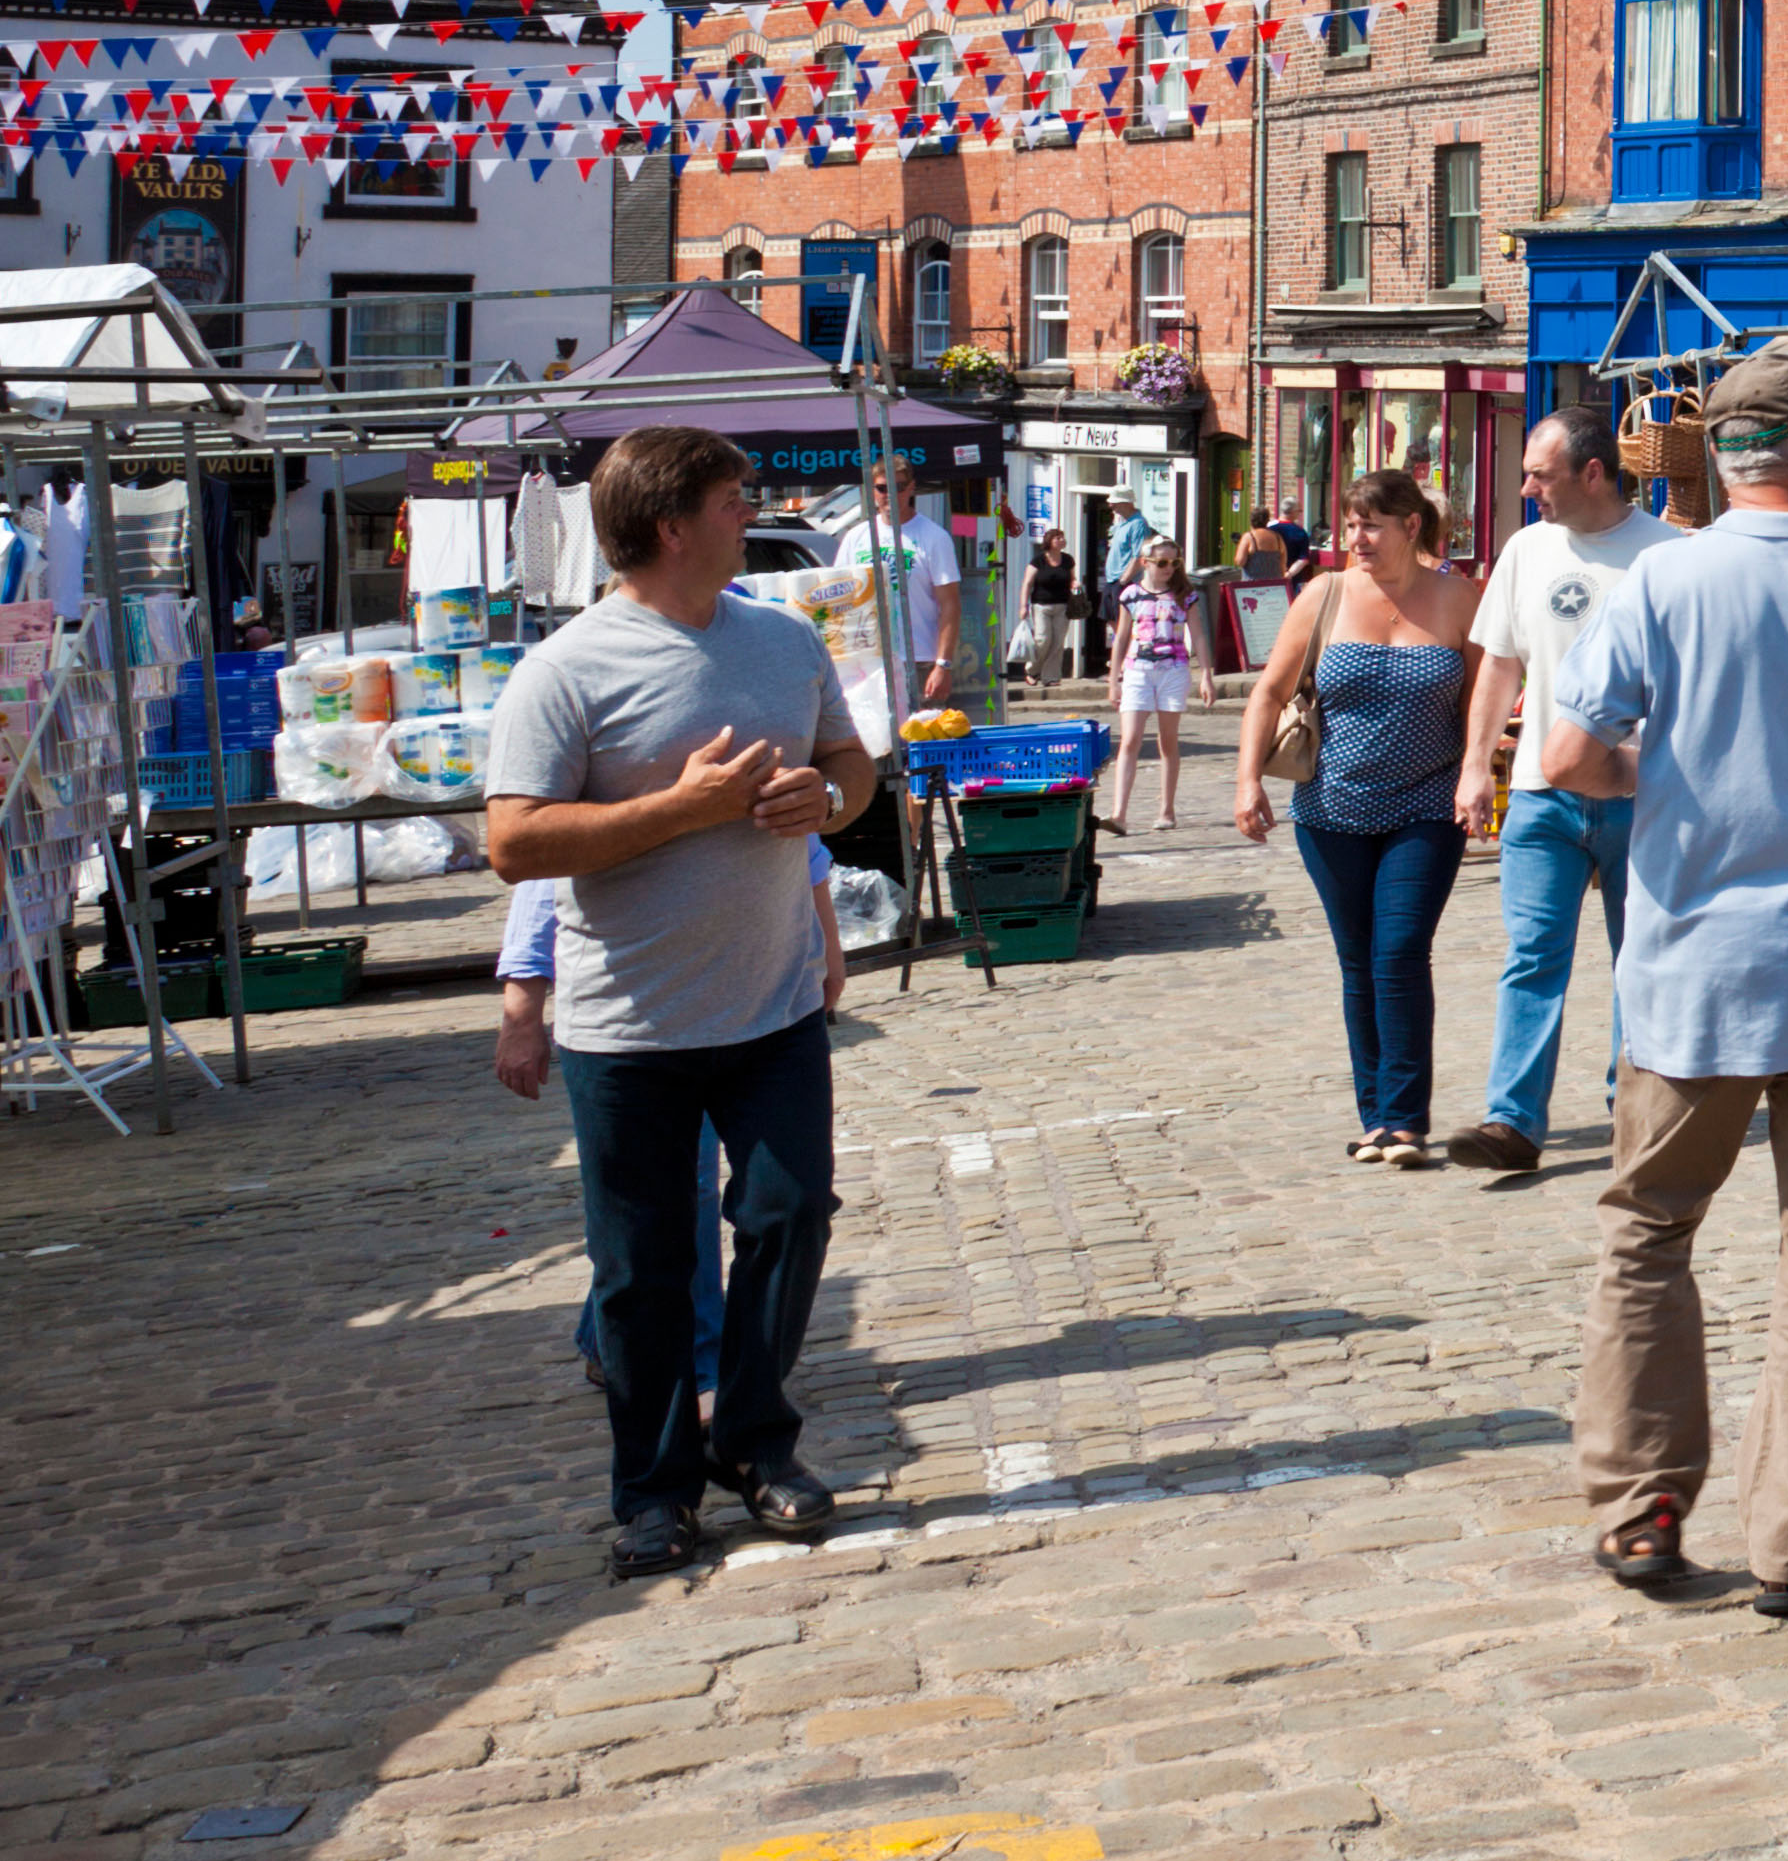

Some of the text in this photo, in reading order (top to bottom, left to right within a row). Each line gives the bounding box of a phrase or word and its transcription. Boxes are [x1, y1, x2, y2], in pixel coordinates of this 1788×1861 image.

[136, 181, 224, 200] VAULTS
[1064, 425, 1119, 447] G T News
